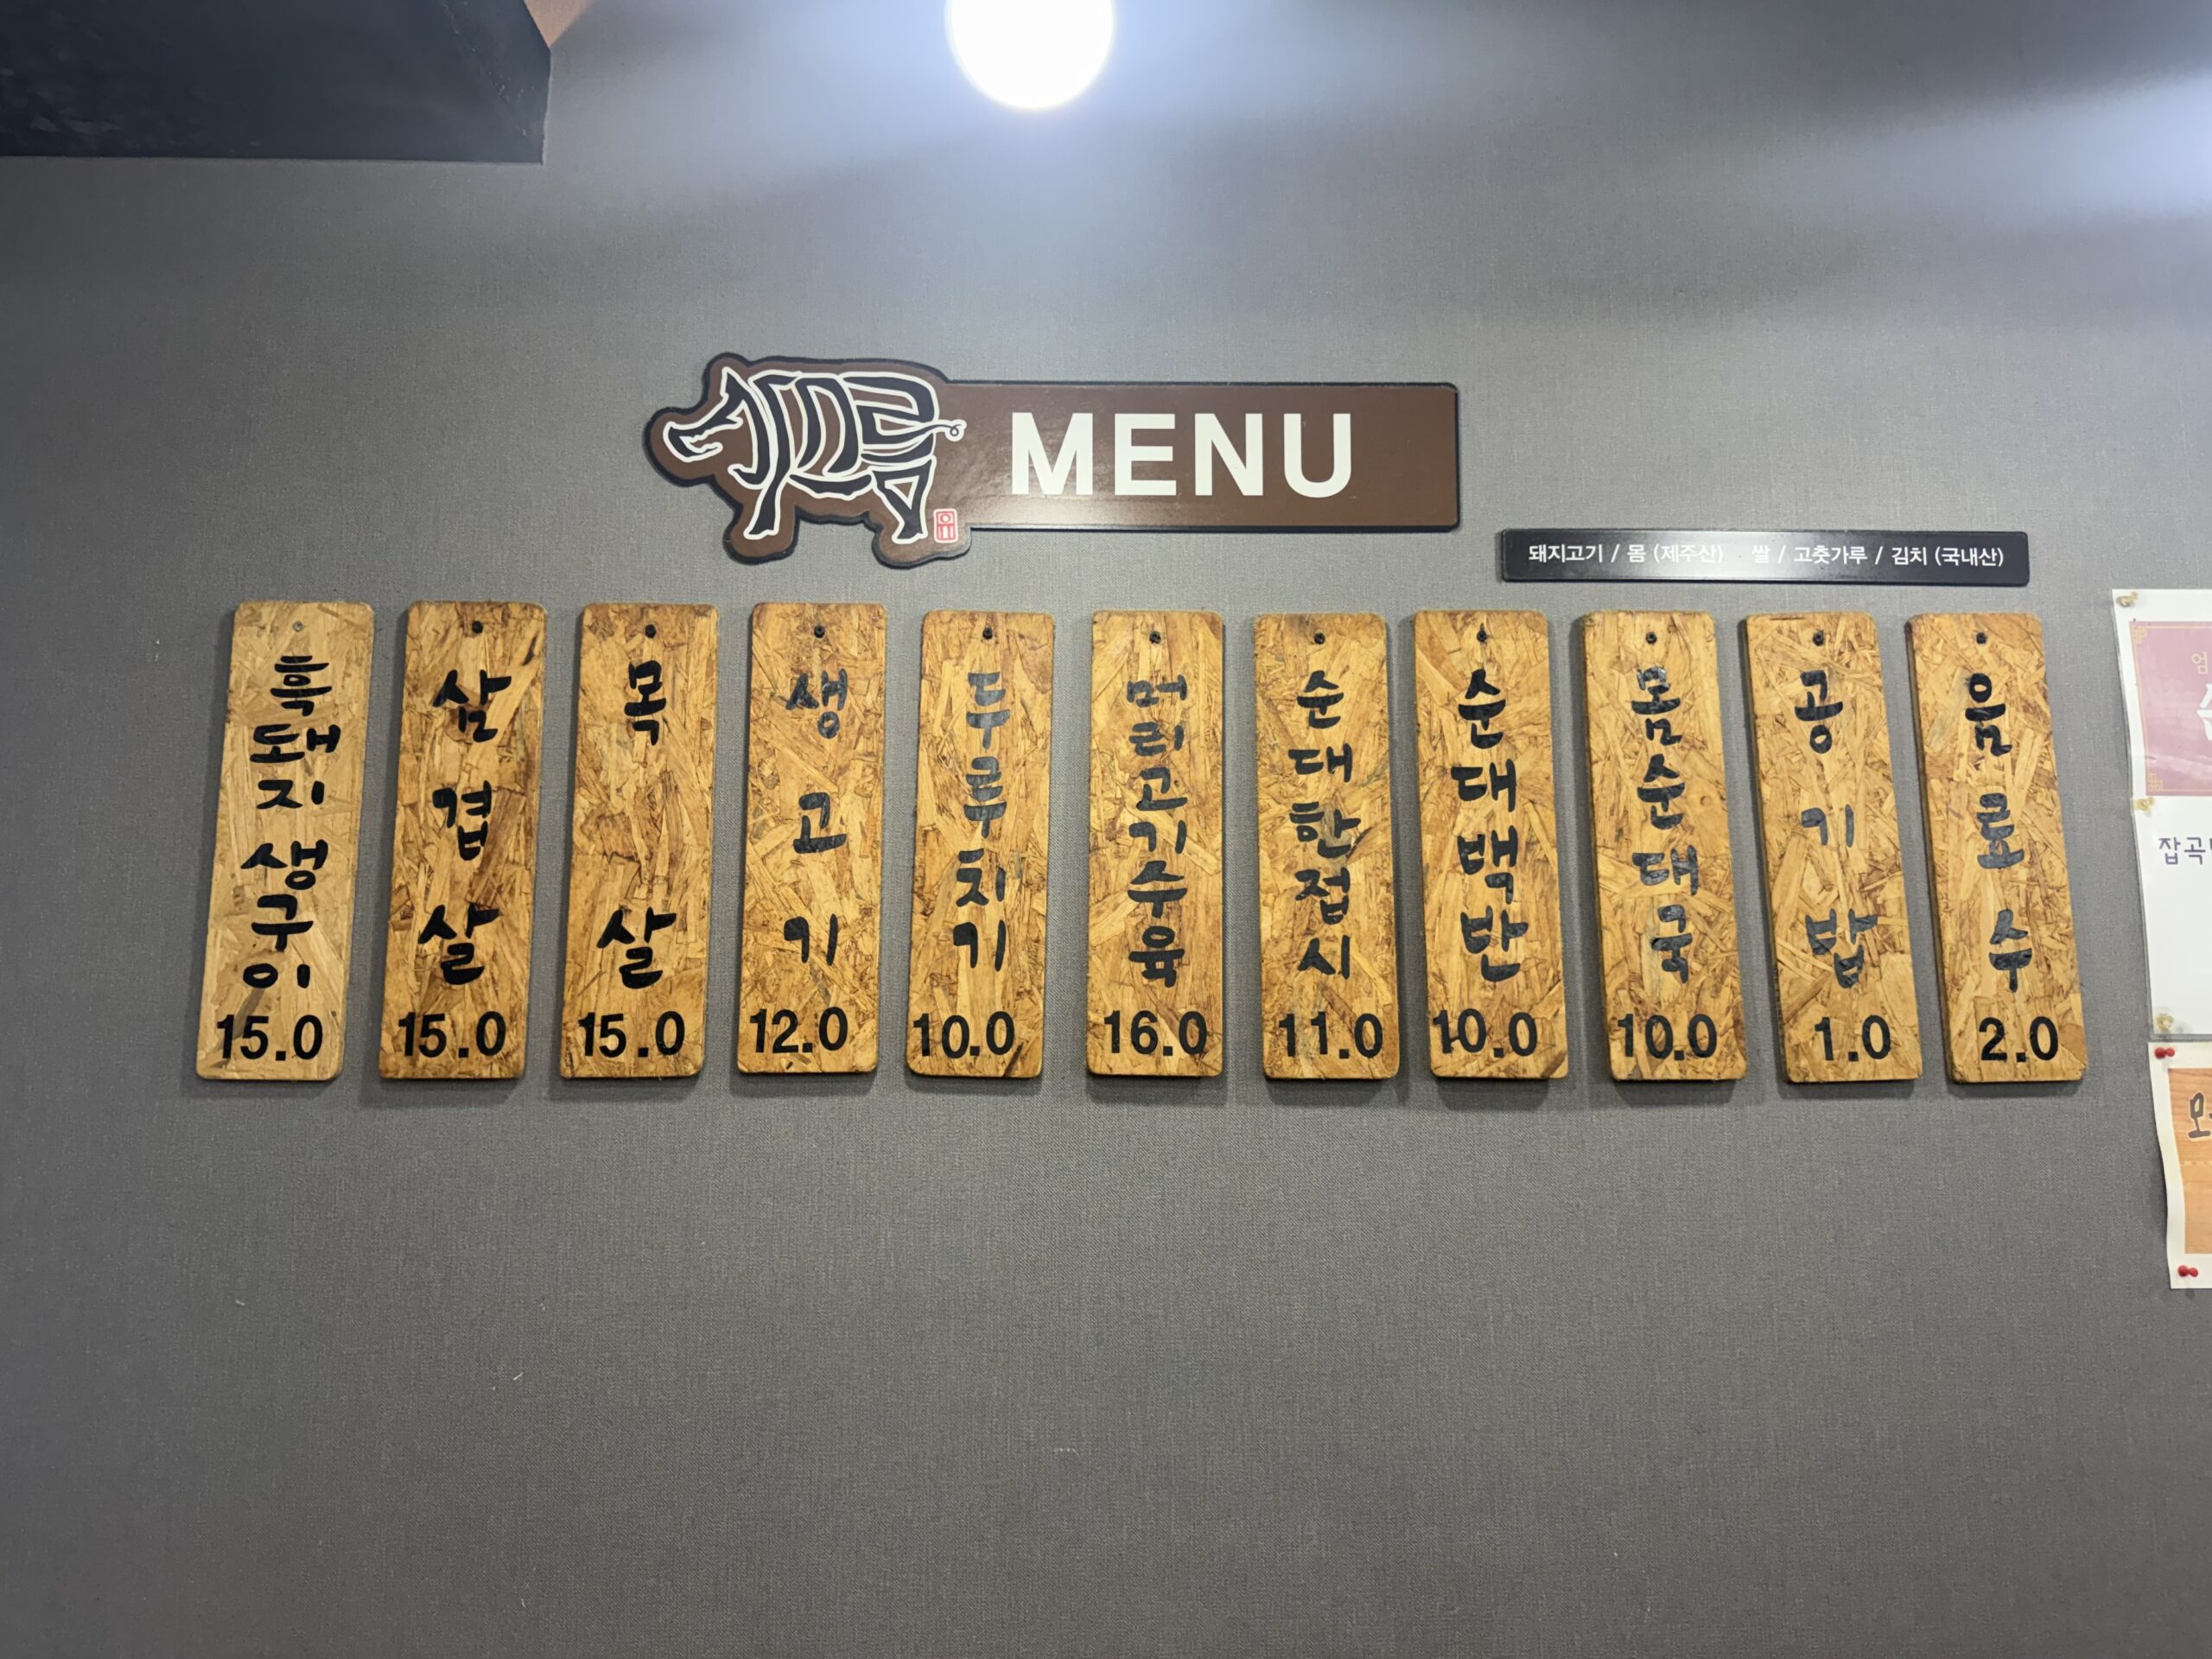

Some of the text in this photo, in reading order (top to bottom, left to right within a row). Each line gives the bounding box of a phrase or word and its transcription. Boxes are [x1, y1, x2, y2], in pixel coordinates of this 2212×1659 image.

[1010, 412, 1352, 499] MENU
[1528, 543, 1604, 563] 돼지고기
[1626, 543, 1647, 563] 몸
[1653, 543, 1724, 564] (제주산)
[1751, 544, 1770, 563] 쌀
[1793, 545, 1868, 564] 고춧가루
[1891, 546, 1928, 565] 김치
[1934, 546, 2005, 567] (국내산)
[951, 671, 1010, 971] 두루치기
[2158, 836, 2212, 865] 잡곡
[217, 1014, 323, 1061] 15.0
[397, 1011, 506, 1058] 15.0
[577, 1011, 685, 1058] 15.0
[749, 1006, 849, 1054] 12.0
[912, 1012, 1015, 1059] 10.0
[1103, 1010, 1208, 1057] 16.0
[1278, 1012, 1383, 1060] 11.0
[1432, 1008, 1538, 1058] 10.0
[1617, 1014, 1718, 1061] 10.0
[1815, 1014, 1891, 1062] 1.0
[1979, 1016, 2058, 1063] 2.0
[2188, 1091, 2212, 1139] 오
